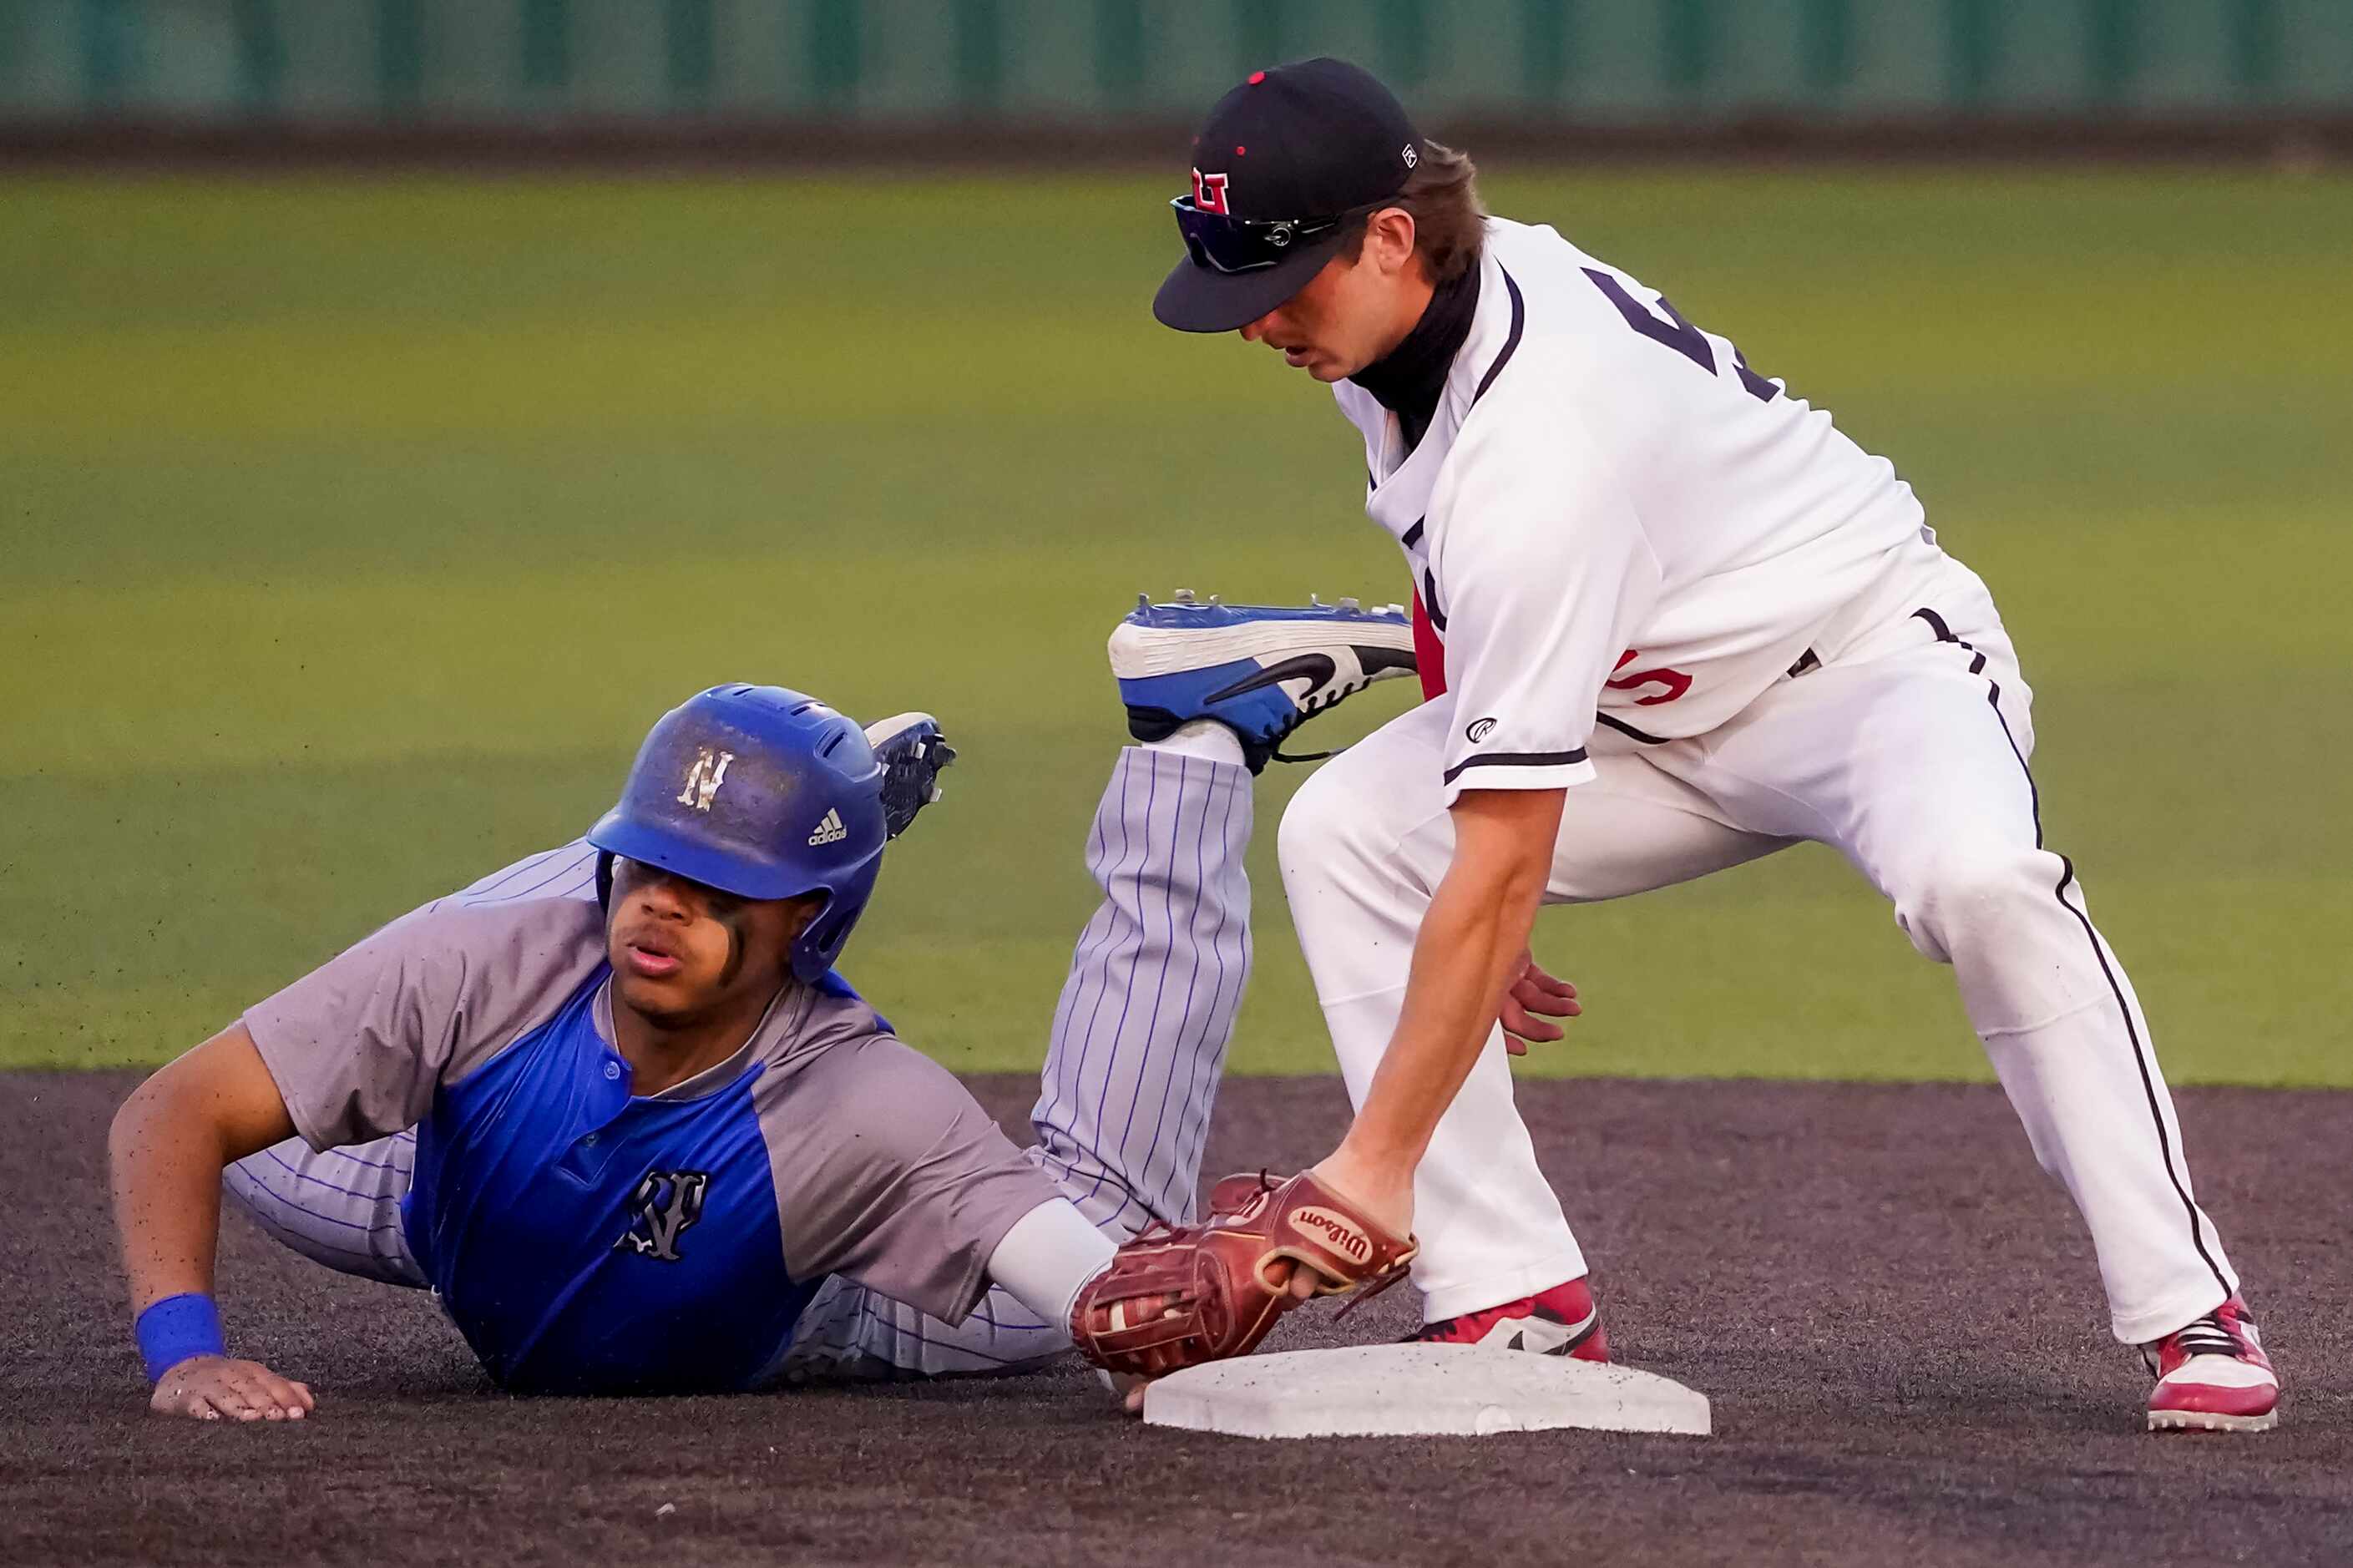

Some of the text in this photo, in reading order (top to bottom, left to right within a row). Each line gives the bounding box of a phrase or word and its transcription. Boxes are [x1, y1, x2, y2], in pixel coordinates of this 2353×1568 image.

[676, 747, 734, 812] N
[808, 824, 848, 846] adidas
[1300, 1211, 1368, 1261] Wilson
